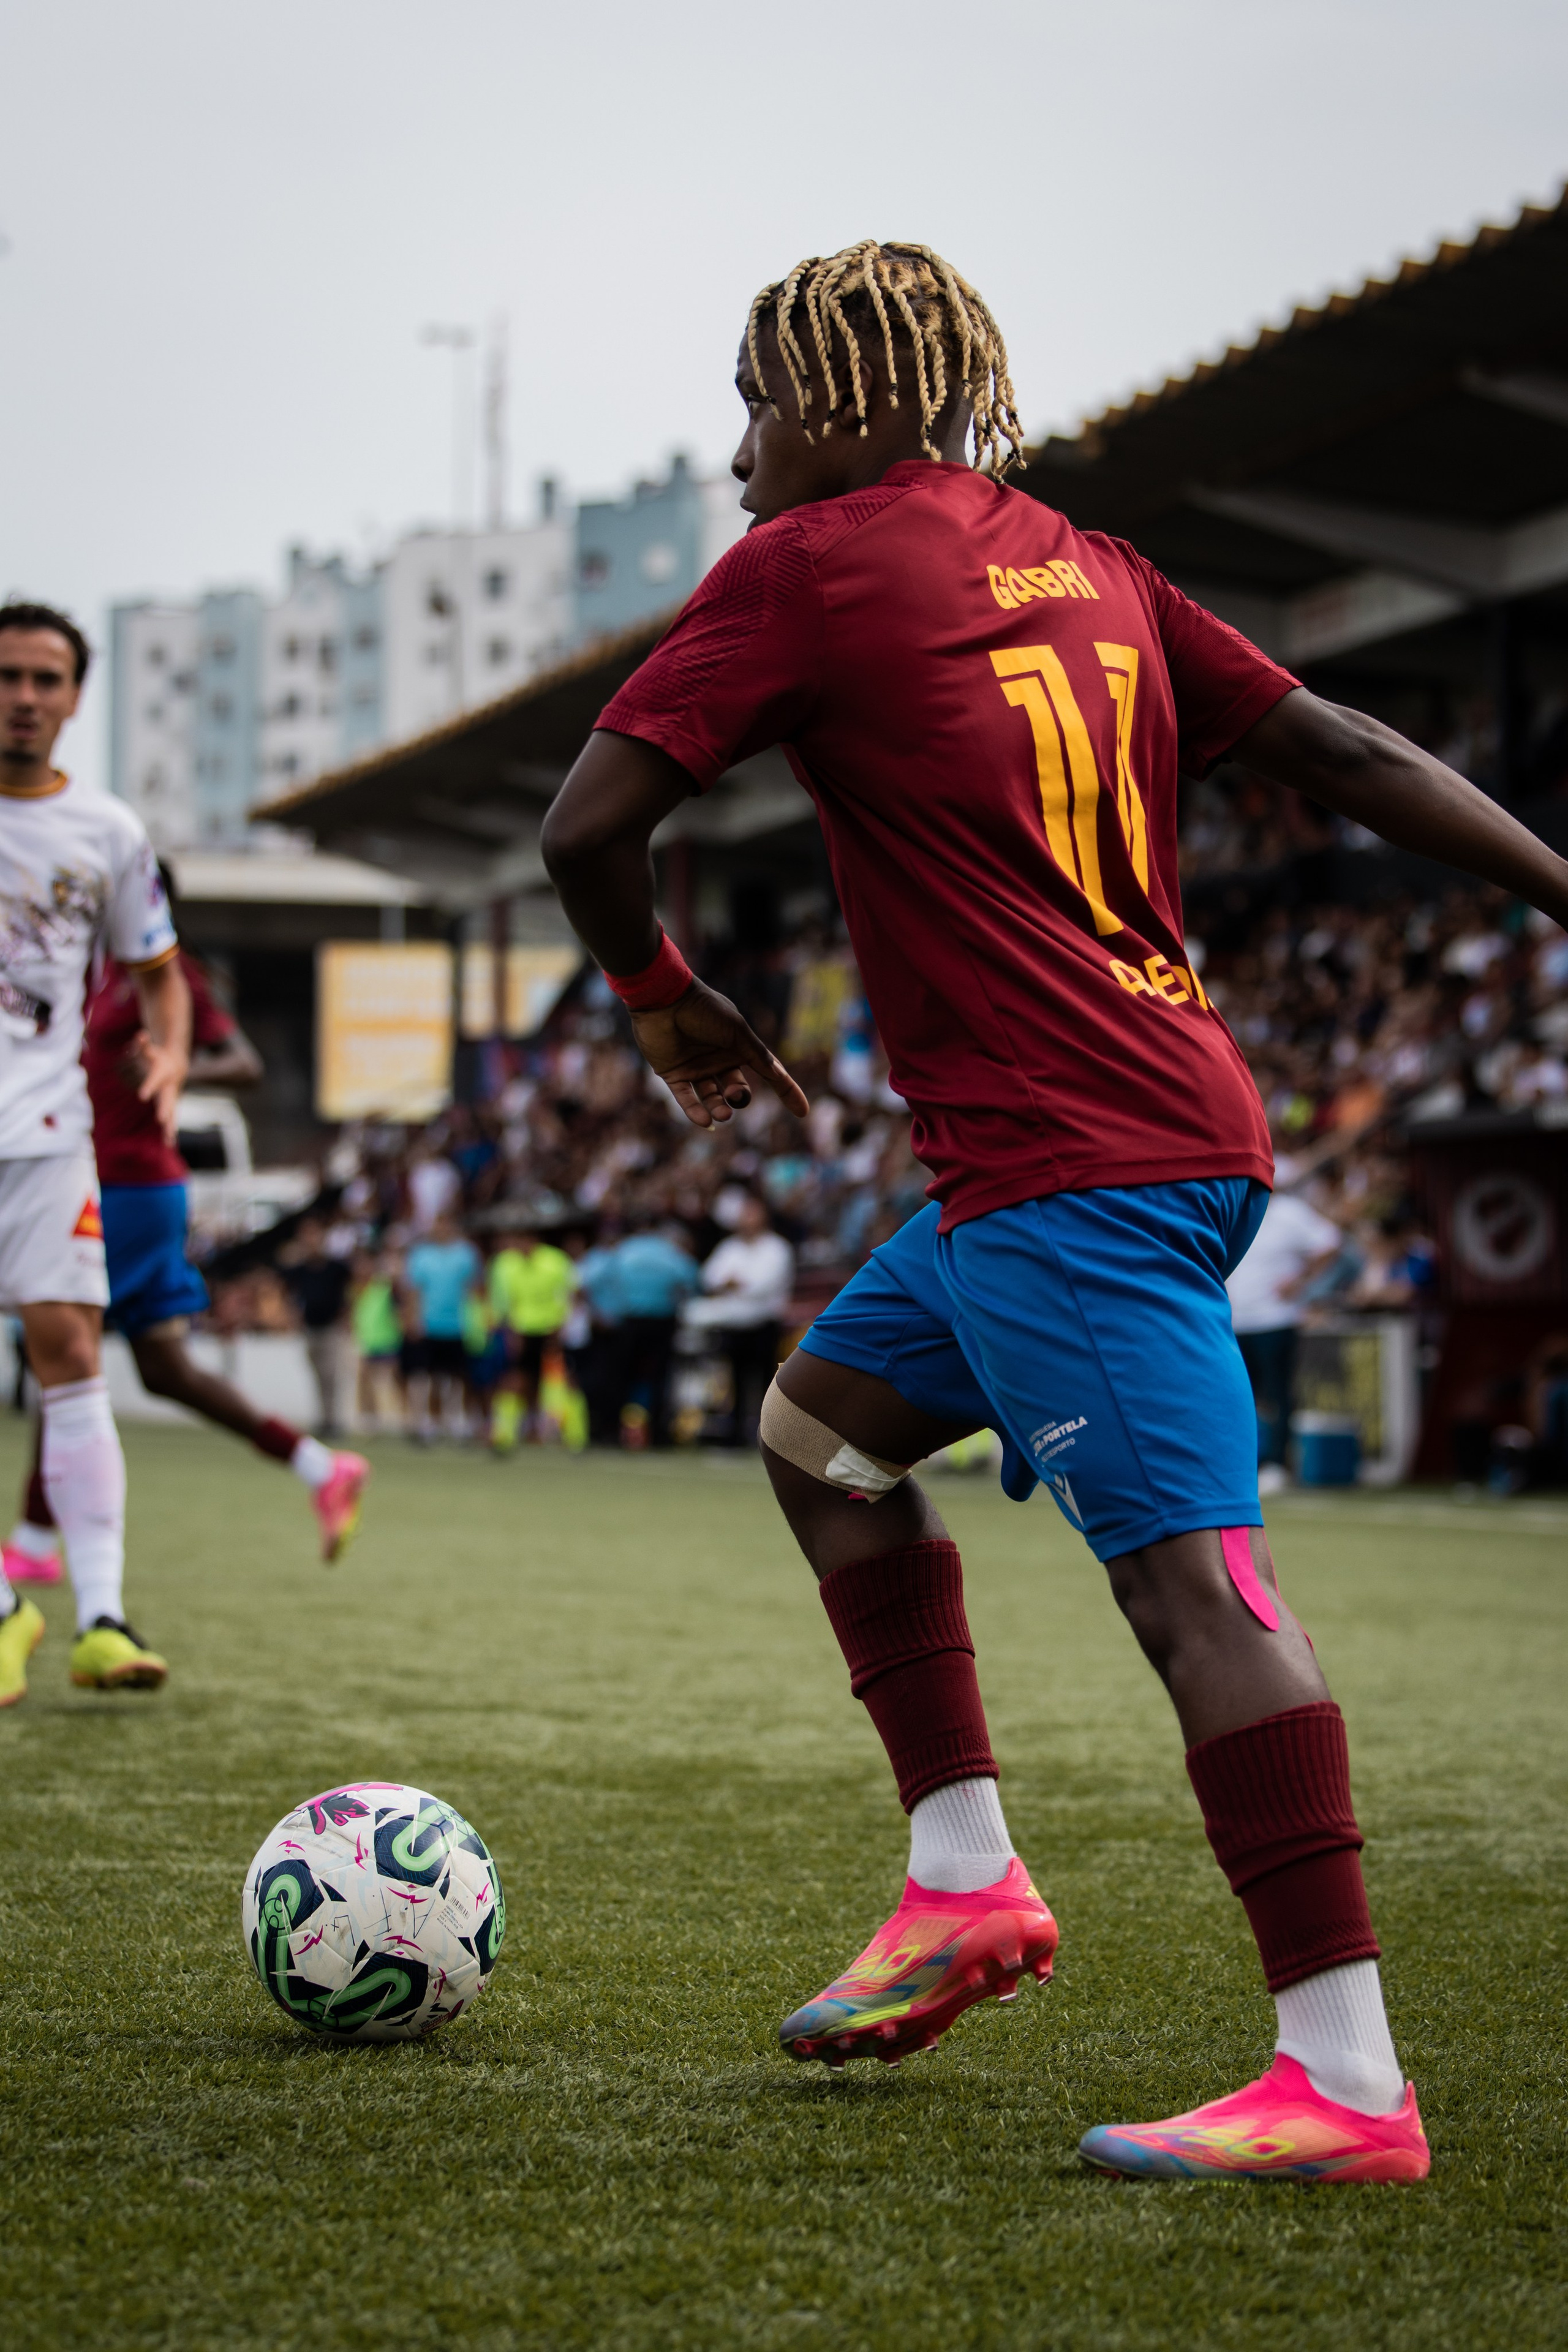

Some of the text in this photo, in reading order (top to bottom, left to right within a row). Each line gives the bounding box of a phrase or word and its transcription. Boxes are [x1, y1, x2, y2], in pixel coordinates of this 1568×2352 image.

[987, 560, 1099, 609] GABRI
[989, 642, 1148, 934] 11
[1042, 1416, 1088, 1446] PORTELA
[442, 1911, 454, 1924] PORTUGAL
